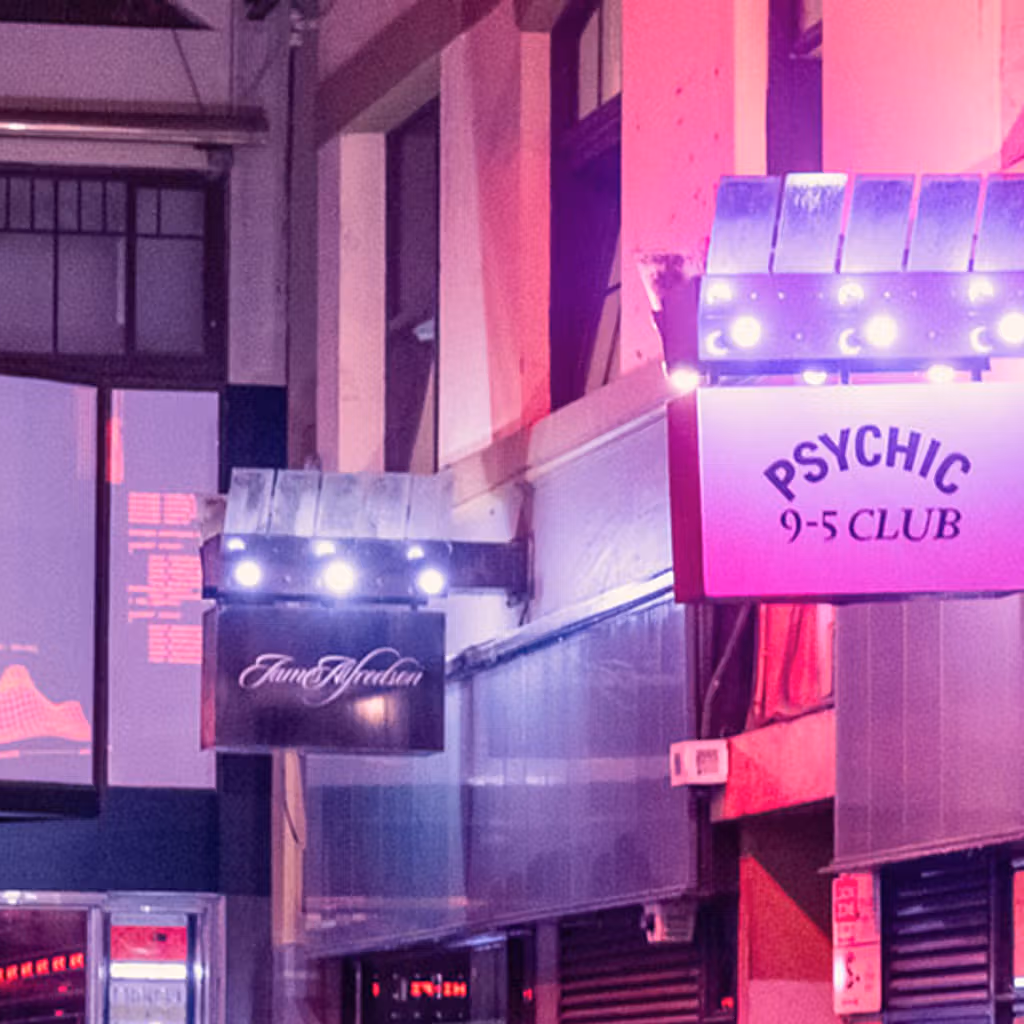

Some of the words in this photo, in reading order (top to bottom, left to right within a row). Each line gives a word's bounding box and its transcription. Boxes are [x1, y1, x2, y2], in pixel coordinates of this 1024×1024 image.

[763, 424, 972, 502] PSYCHIC
[780, 508, 838, 545] 9-5
[848, 507, 963, 542] CLUB
